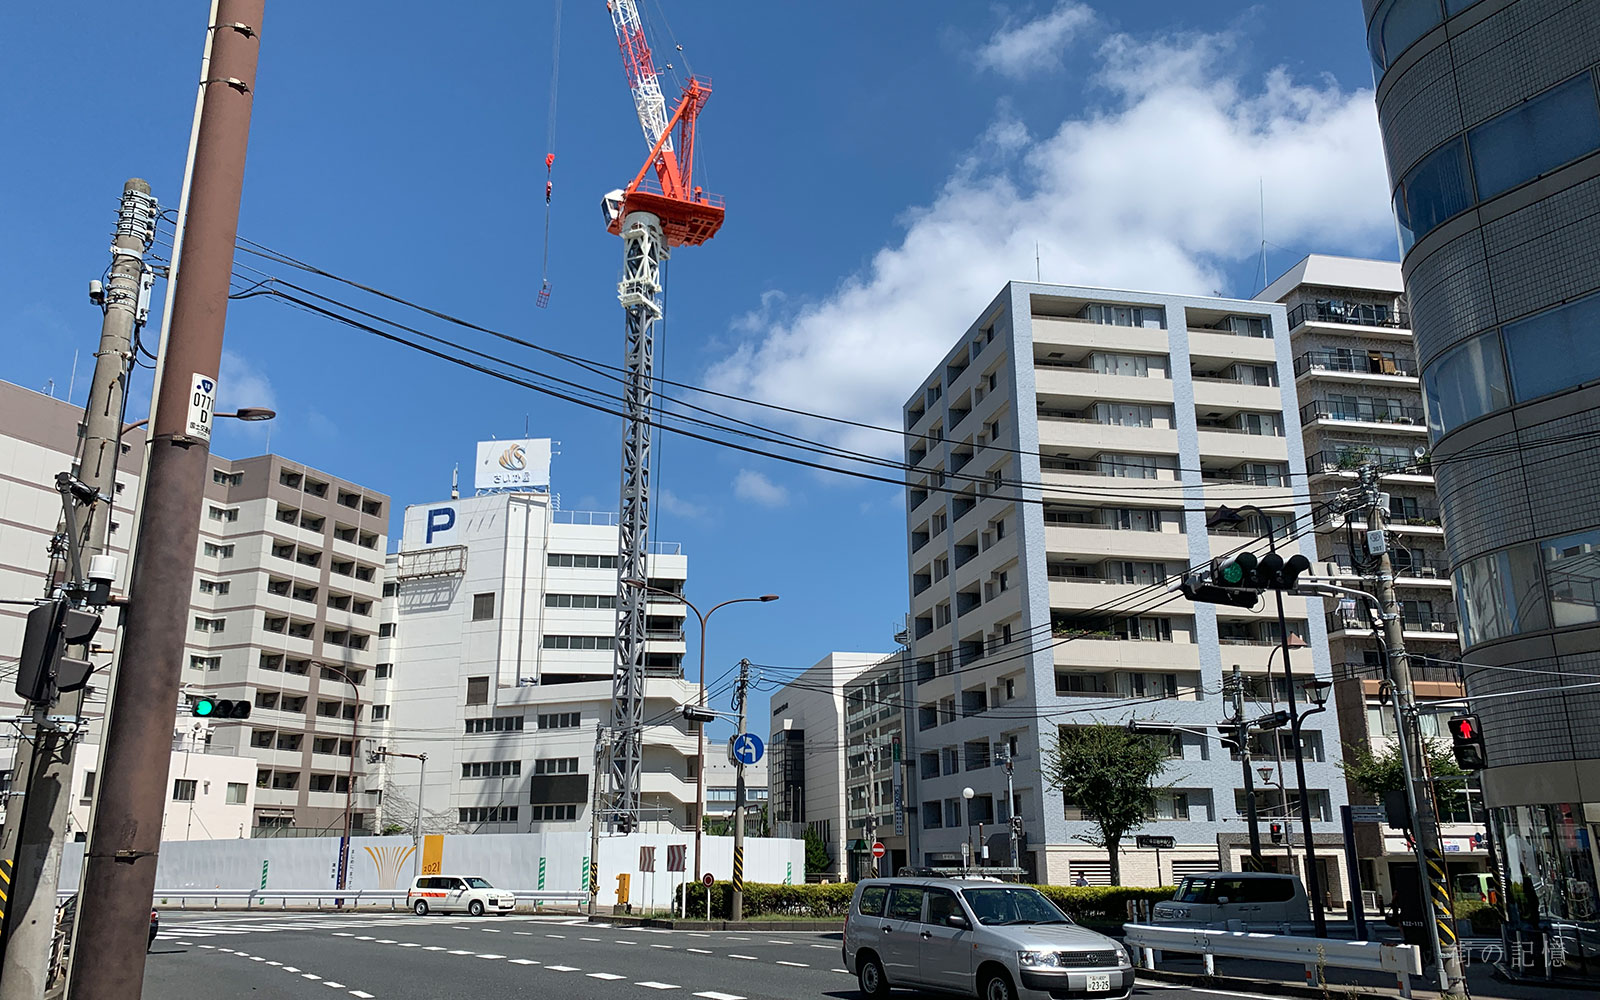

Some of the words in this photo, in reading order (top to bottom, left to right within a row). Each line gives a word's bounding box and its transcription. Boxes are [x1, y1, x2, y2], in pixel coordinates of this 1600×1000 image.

[200, 409, 208, 424] D
[493, 471, 531, 484] さいか屋
[426, 507, 456, 544] P
[423, 861, 440, 873] 2021
